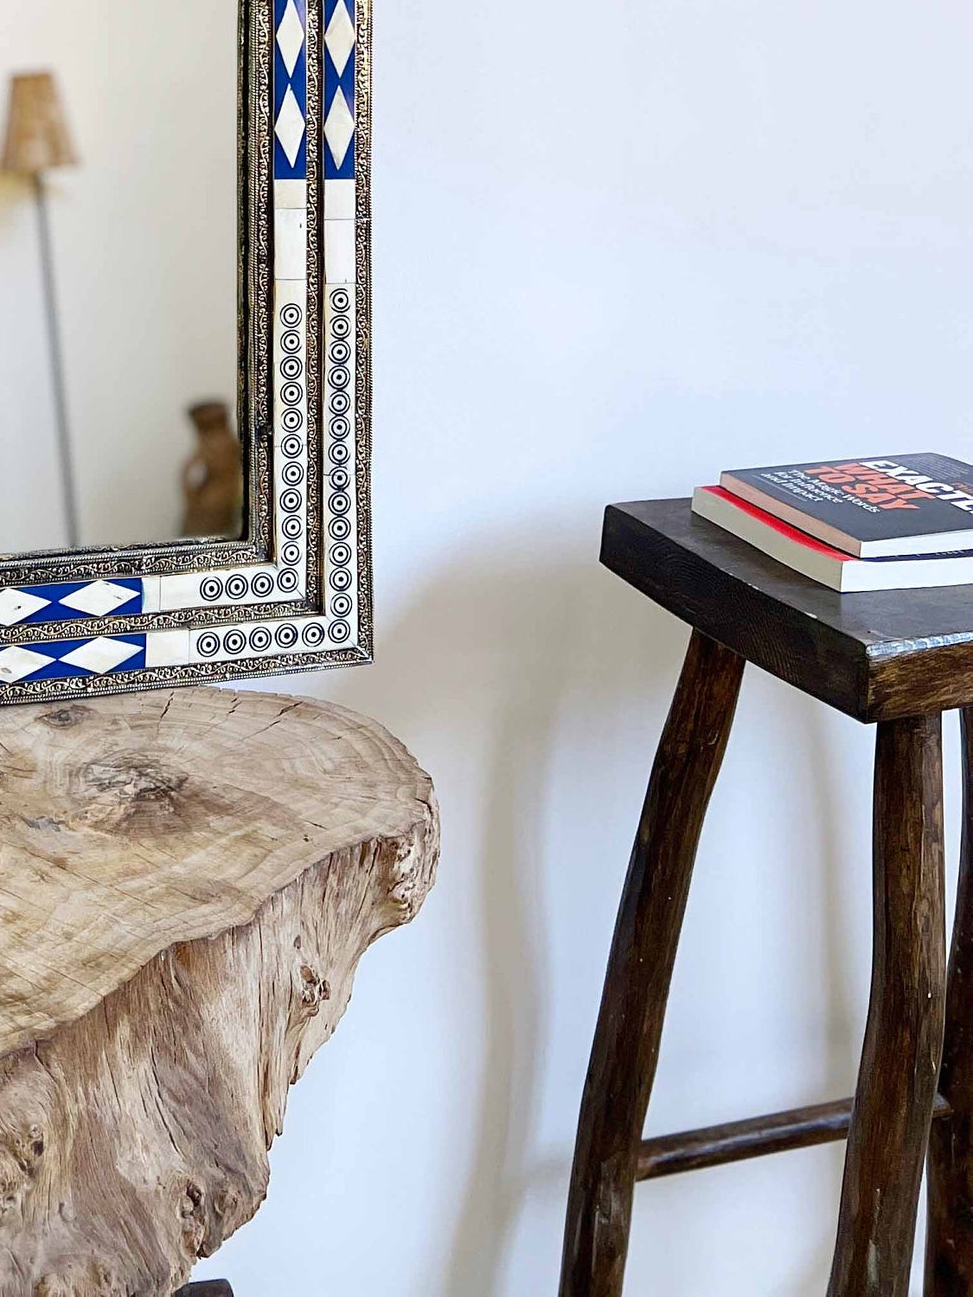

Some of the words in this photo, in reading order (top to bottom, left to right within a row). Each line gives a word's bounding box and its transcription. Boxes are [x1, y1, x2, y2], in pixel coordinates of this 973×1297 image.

[760, 473, 788, 484] and
[781, 482, 824, 502] Impact
[773, 471, 793, 479] for
[787, 478, 843, 503] Influence
[787, 469, 811, 480] The
[808, 479, 845, 496] Magic
[842, 494, 880, 513] Words
[804, 465, 856, 483] TO
[841, 483, 920, 510] SAY
[833, 462, 936, 499] WHAT
[859, 460, 973, 514] EXACTL
